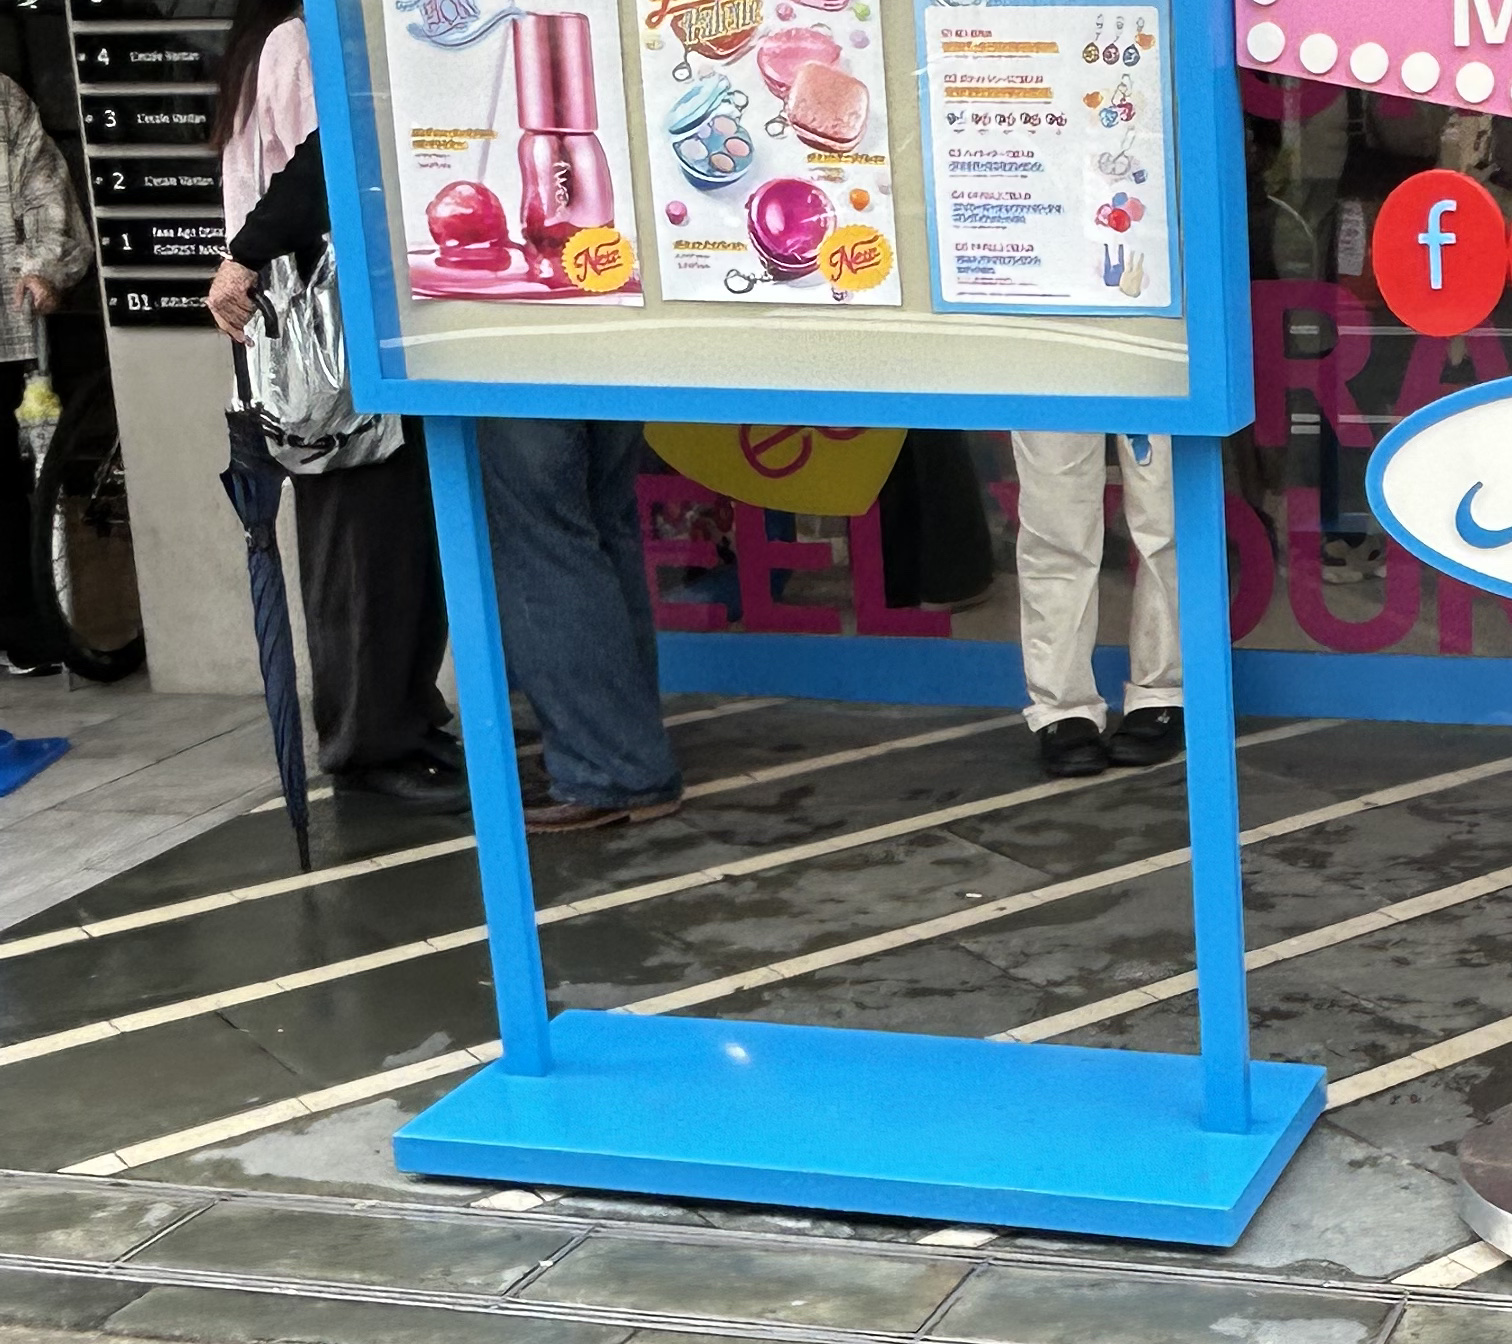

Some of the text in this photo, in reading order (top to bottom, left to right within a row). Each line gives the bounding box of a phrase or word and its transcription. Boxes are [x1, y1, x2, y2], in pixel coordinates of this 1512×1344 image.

[97, 48, 110, 66] 4
[104, 110, 117, 128] 3
[112, 172, 126, 190] 2
[121, 233, 132, 251] 1
[127, 293, 152, 311] B1
